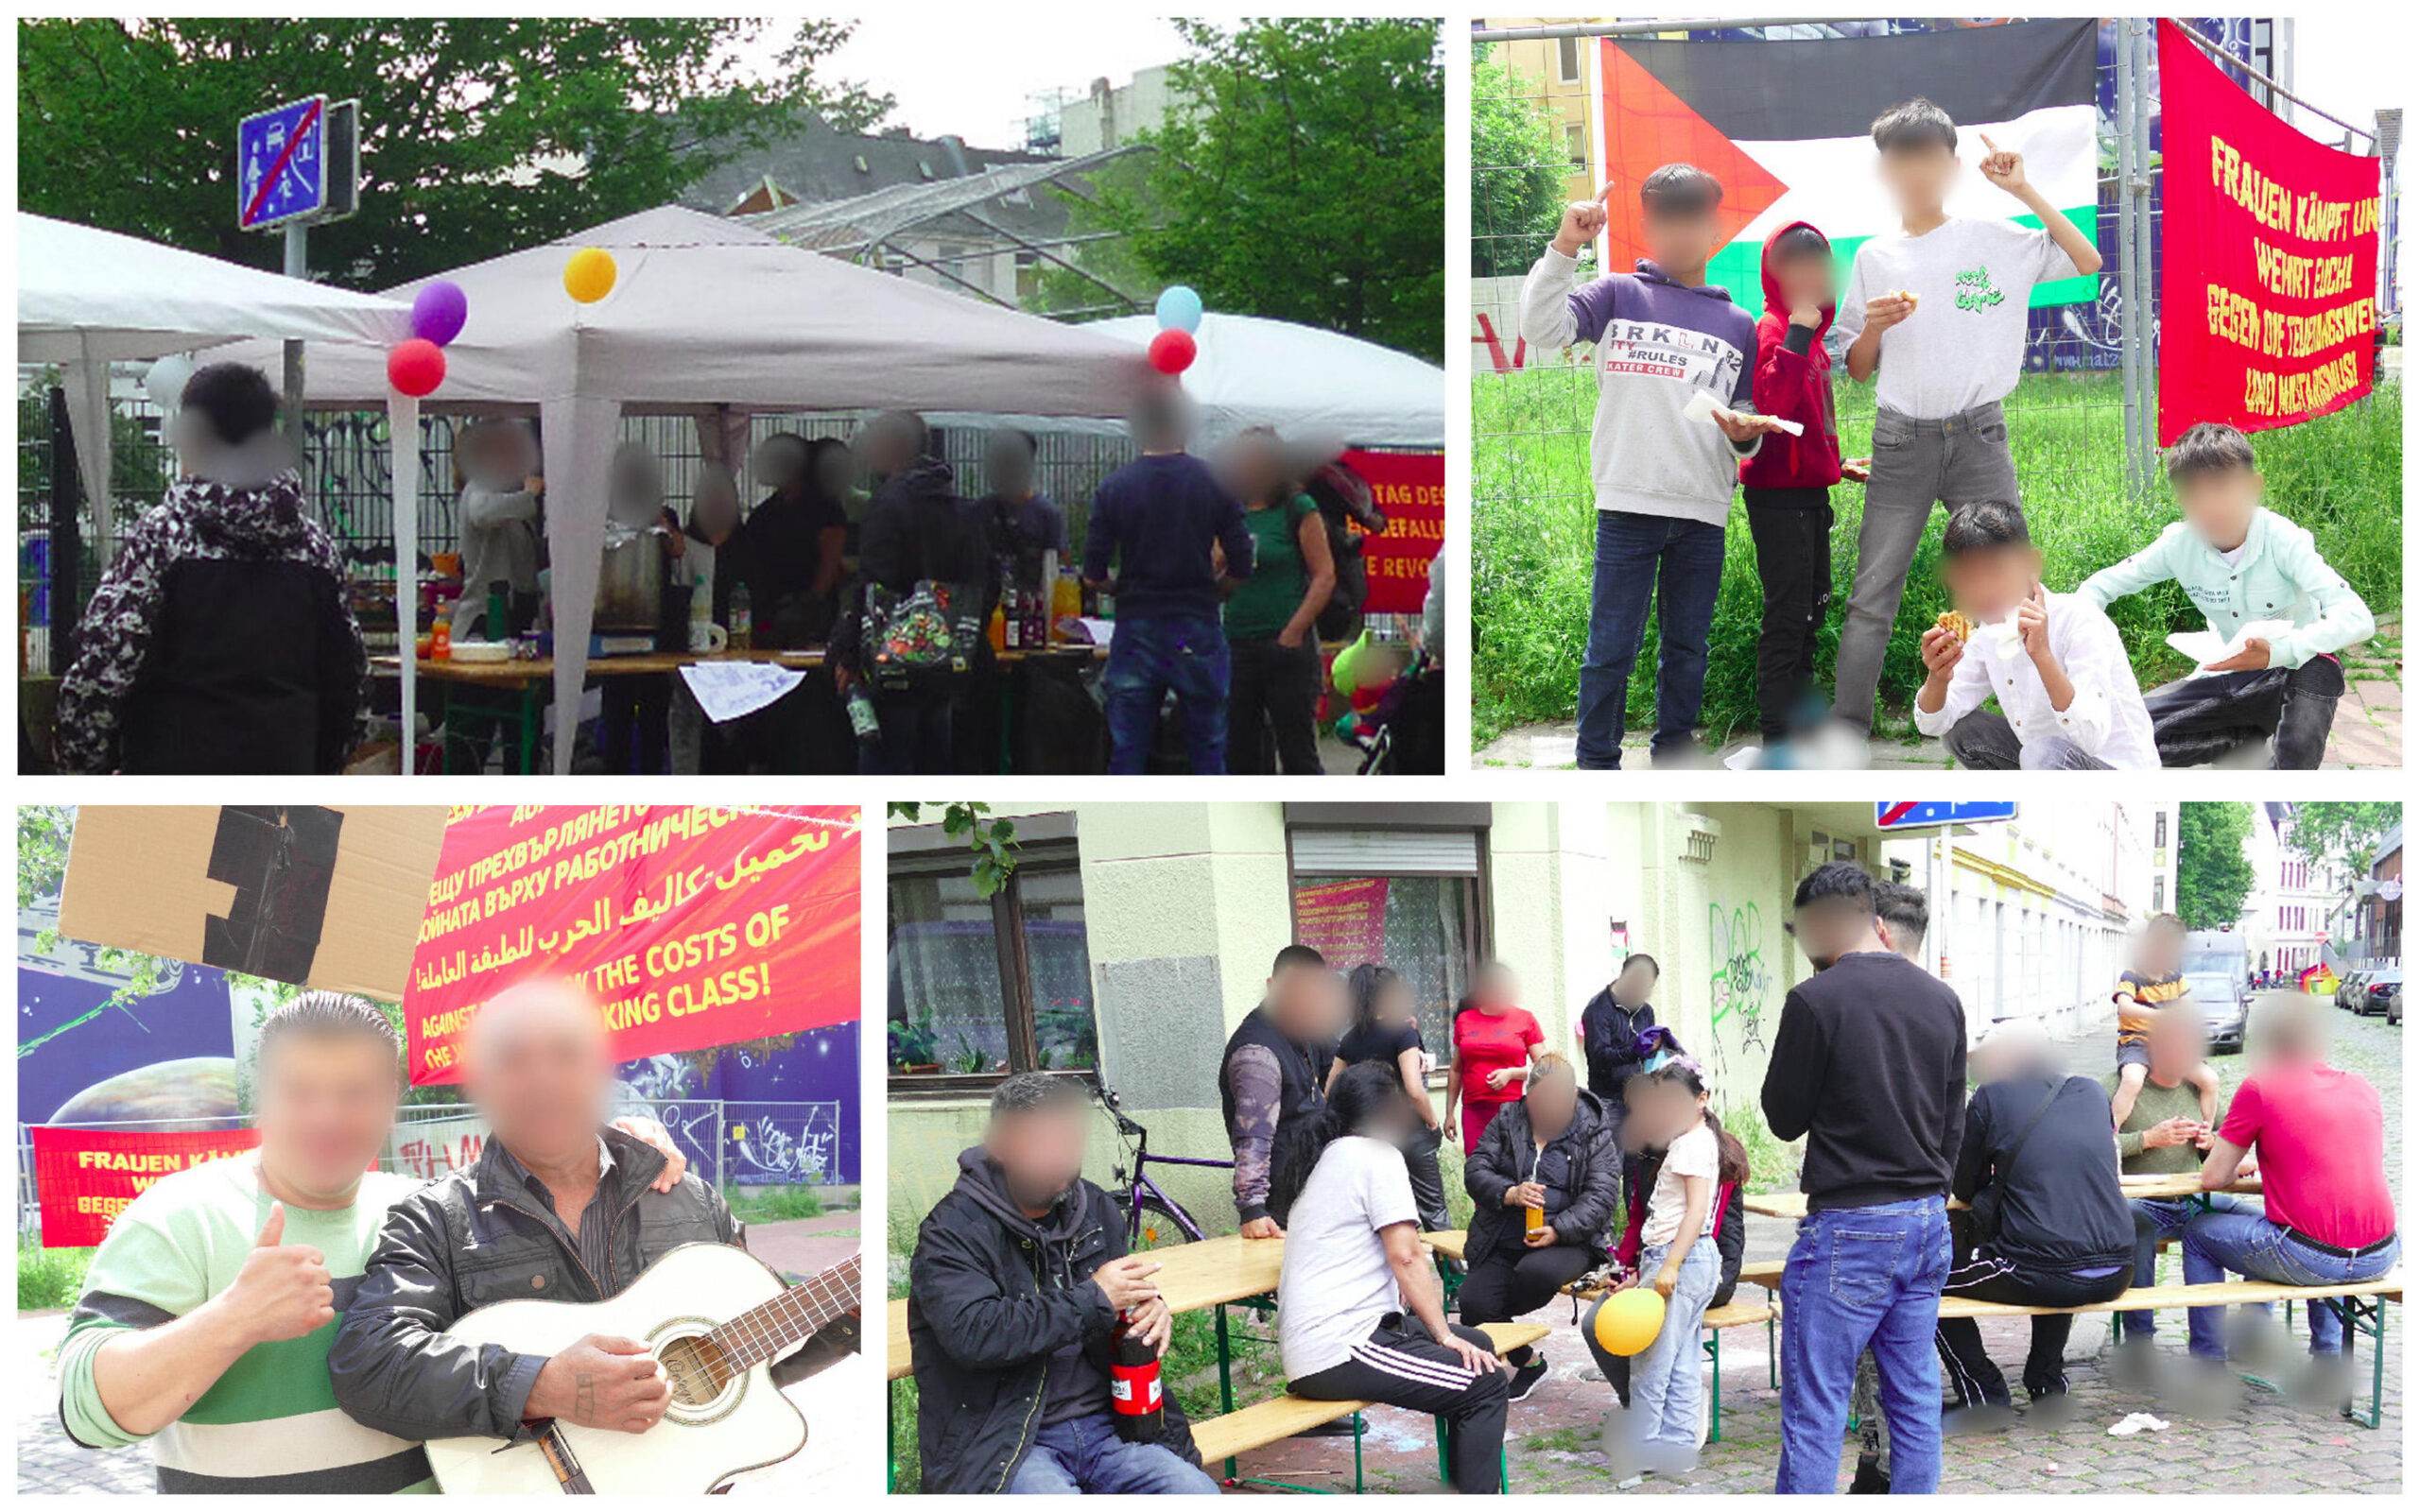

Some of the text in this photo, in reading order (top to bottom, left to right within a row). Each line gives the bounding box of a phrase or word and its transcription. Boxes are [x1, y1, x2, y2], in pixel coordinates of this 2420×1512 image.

[2211, 134, 2291, 233] FRAUEN
[2296, 192, 2351, 242] KÄMPFT
[2254, 236, 2354, 300] WEHRT EUCH!
[2207, 284, 2260, 351] GEGEN
[2263, 309, 2285, 358] DIE
[1628, 351, 1687, 367] #RULES
[1648, 365, 1682, 377] CREW
[2244, 368, 2275, 416] UND
[1373, 485, 1411, 505] TAG
[485, 867, 551, 918] ВЪРХУ
[538, 897, 610, 954] الحرب
[594, 954, 640, 991] THE
[647, 922, 736, 977] COSTS
[745, 903, 789, 948] OF
[667, 962, 771, 1018] CLASS!
[78, 1151, 181, 1172] FRAUEN
